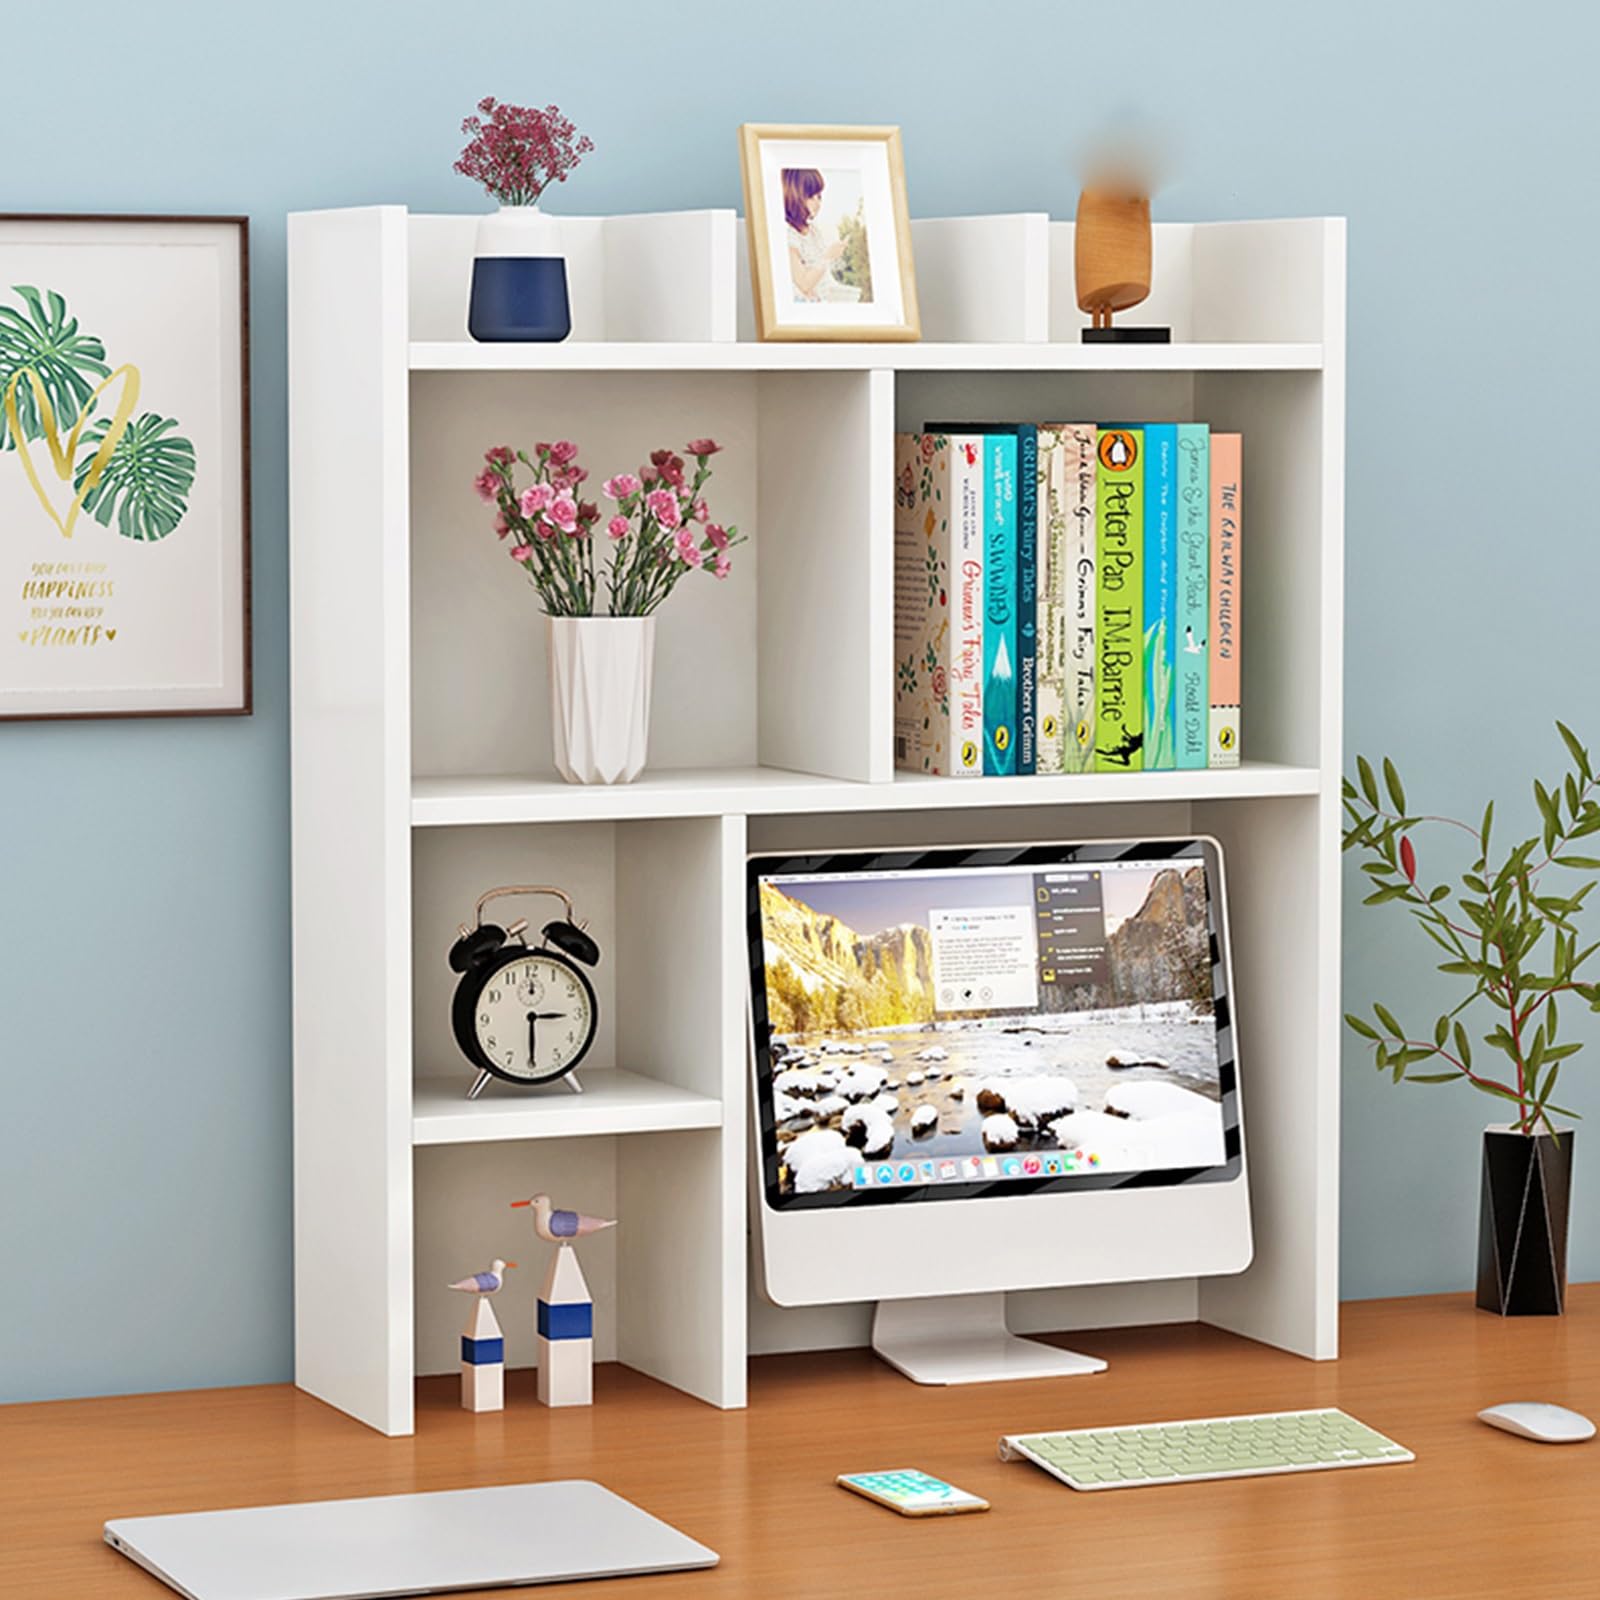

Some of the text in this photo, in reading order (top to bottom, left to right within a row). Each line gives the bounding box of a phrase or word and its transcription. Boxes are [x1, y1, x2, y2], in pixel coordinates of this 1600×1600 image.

[1178, 438, 1206, 484] James
[1020, 436, 1036, 603] GRIMM'S Fairy Tales
[1187, 506, 1204, 528] the
[1101, 478, 1136, 592] Peter Pan
[1180, 530, 1206, 572] Giant
[1218, 483, 1238, 660] THE RAILWAY CHILDREN
[1072, 626, 1095, 660] Fairy
[951, 634, 982, 682] Fairy
[1077, 666, 1094, 707] Tales
[961, 682, 982, 731] Tales
[1022, 657, 1035, 764] Brothers Grimm
[1184, 671, 1203, 756] Roald Dahl
[505, 971, 517, 985] 11
[525, 964, 539, 979] 12
[488, 989, 502, 1004] 10
[565, 983, 577, 998] 2
[480, 1013, 491, 1028] 9
[573, 1007, 583, 1021] 3
[486, 1036, 497, 1050] 8
[566, 1031, 575, 1044] 4
[505, 1050, 515, 1065] 7
[552, 1048, 562, 1062] 5
